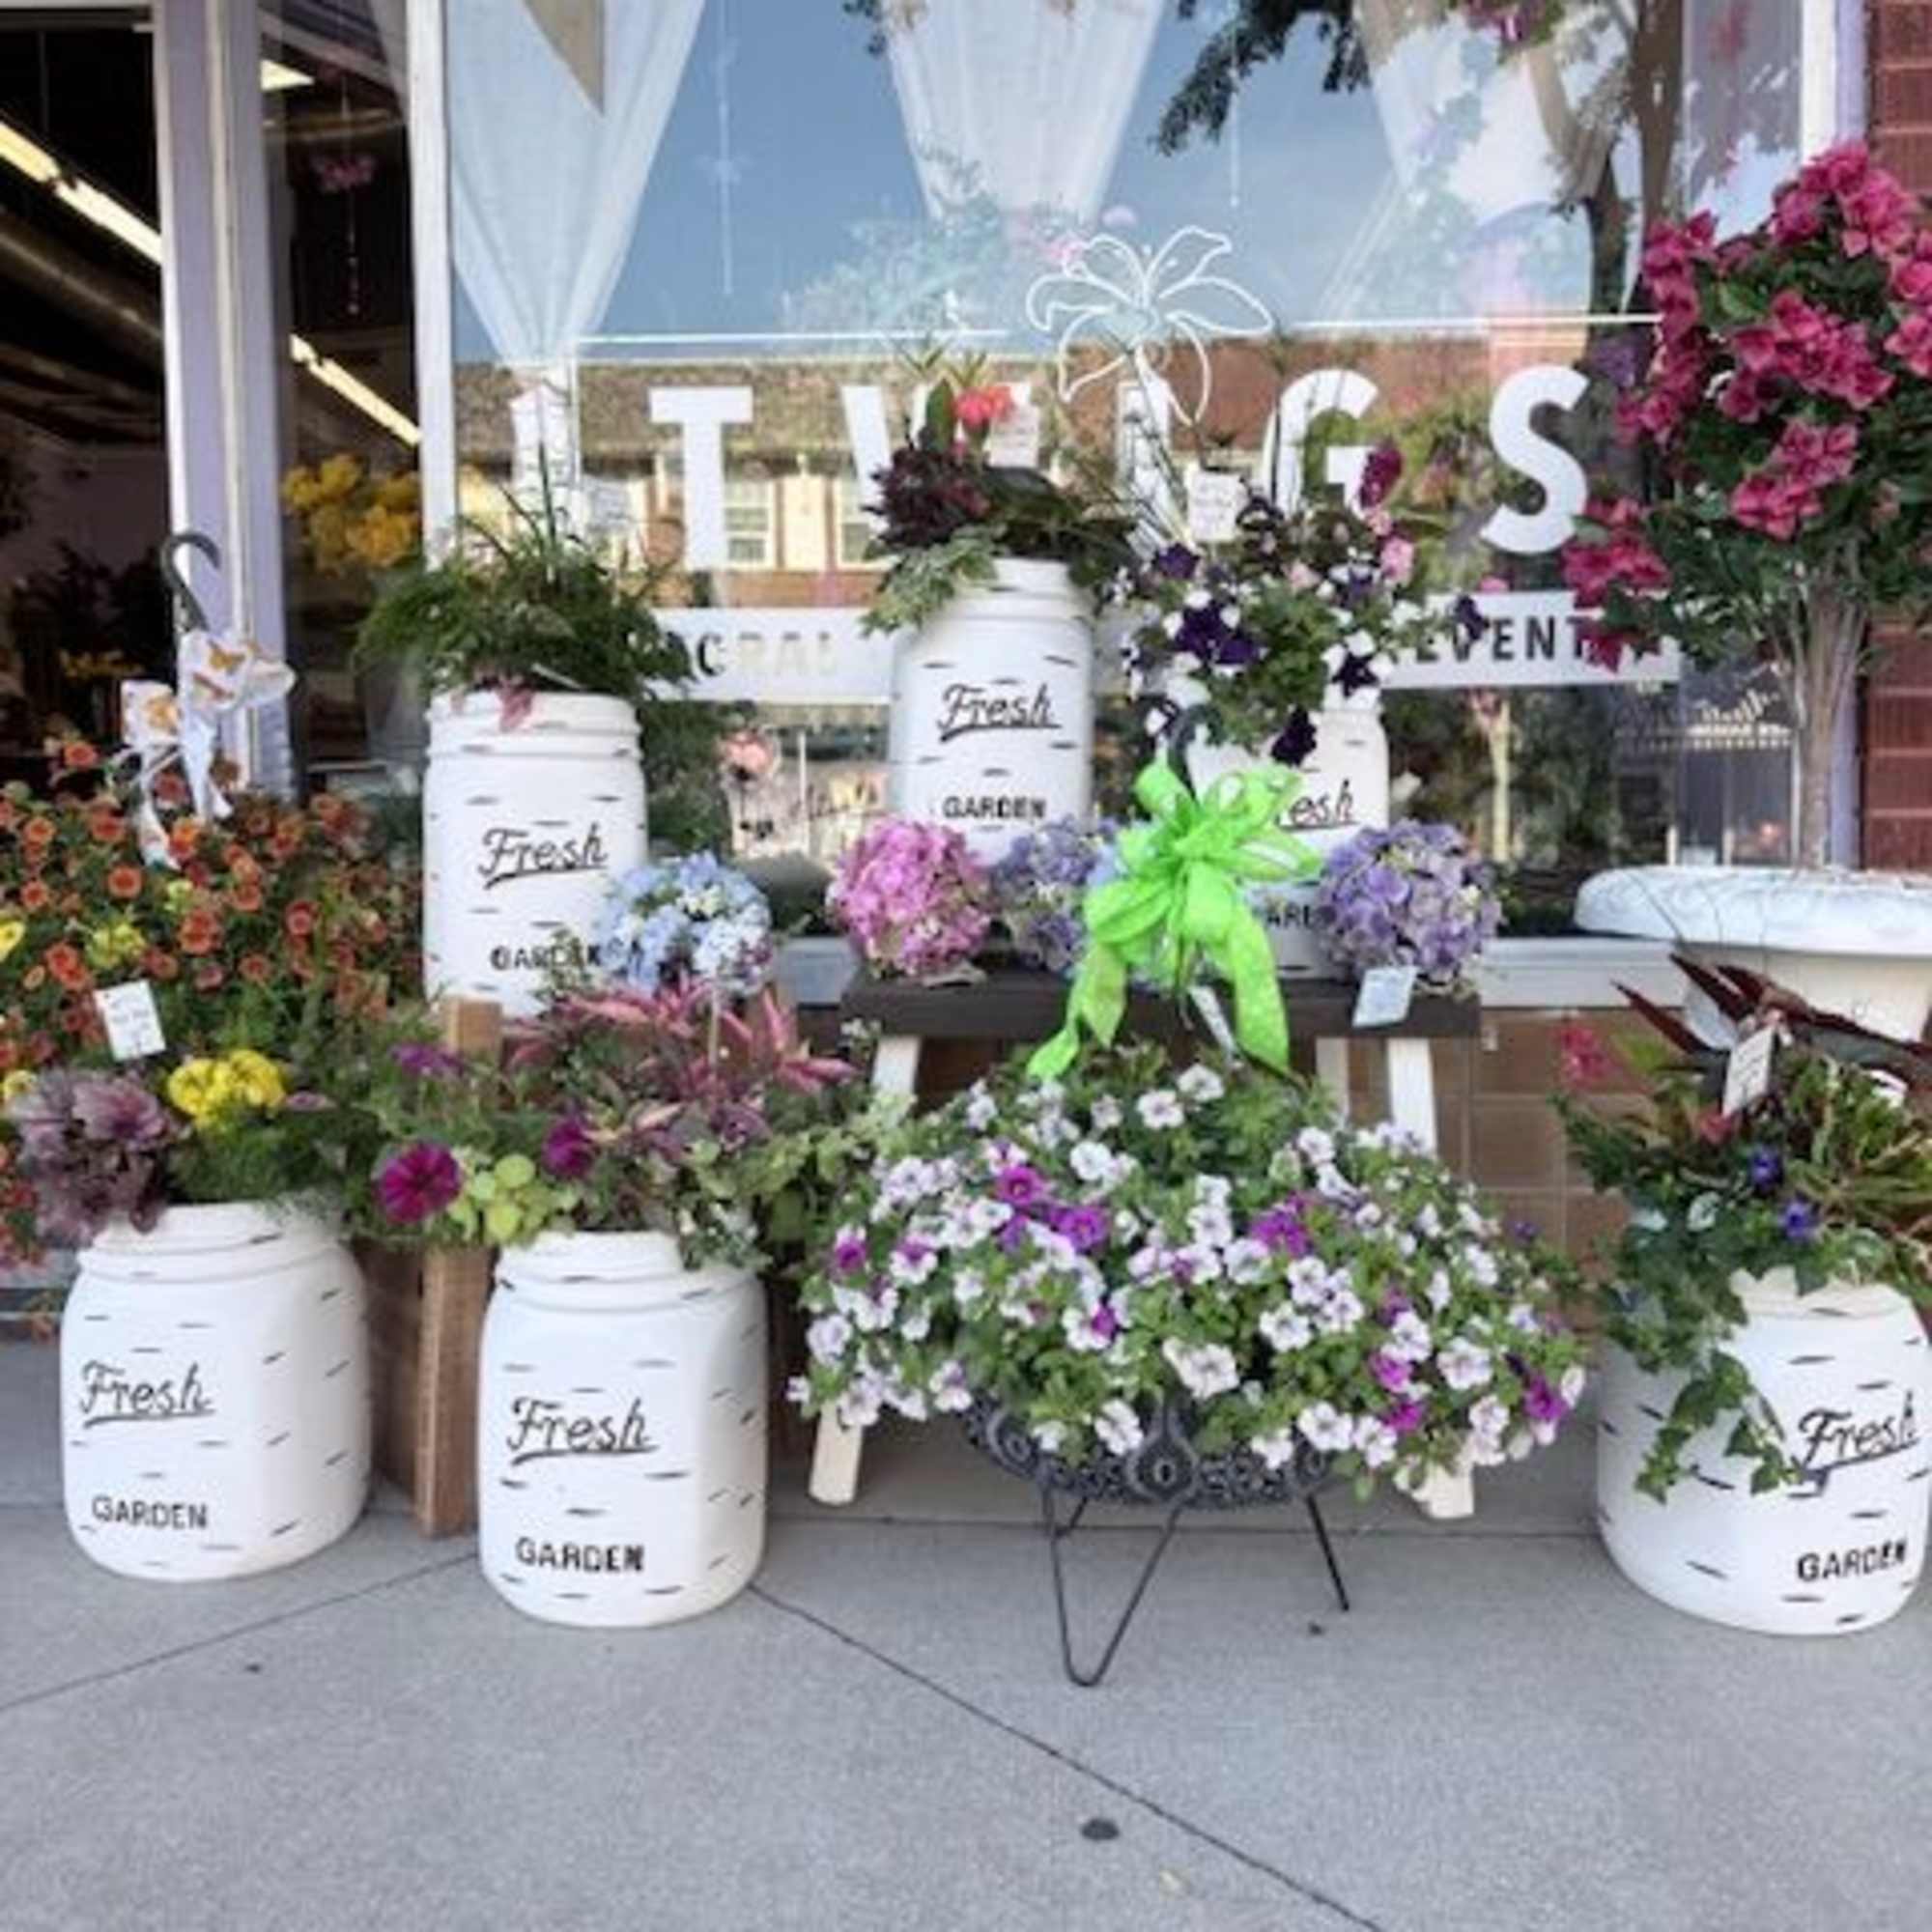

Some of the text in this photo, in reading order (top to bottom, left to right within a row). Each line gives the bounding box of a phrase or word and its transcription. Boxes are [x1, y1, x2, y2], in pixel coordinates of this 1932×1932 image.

[937, 684, 1061, 742] Fresh
[1277, 779, 1354, 831] esh
[478, 823, 609, 890] Fresh
[80, 1361, 214, 1429] Fresh
[507, 1397, 659, 1466] Fresh
[1790, 1391, 1918, 1474] Fresh
[93, 1496, 209, 1529] GARDEN
[516, 1537, 645, 1572] GARDEN
[1798, 1539, 1907, 1582] GARDEN
